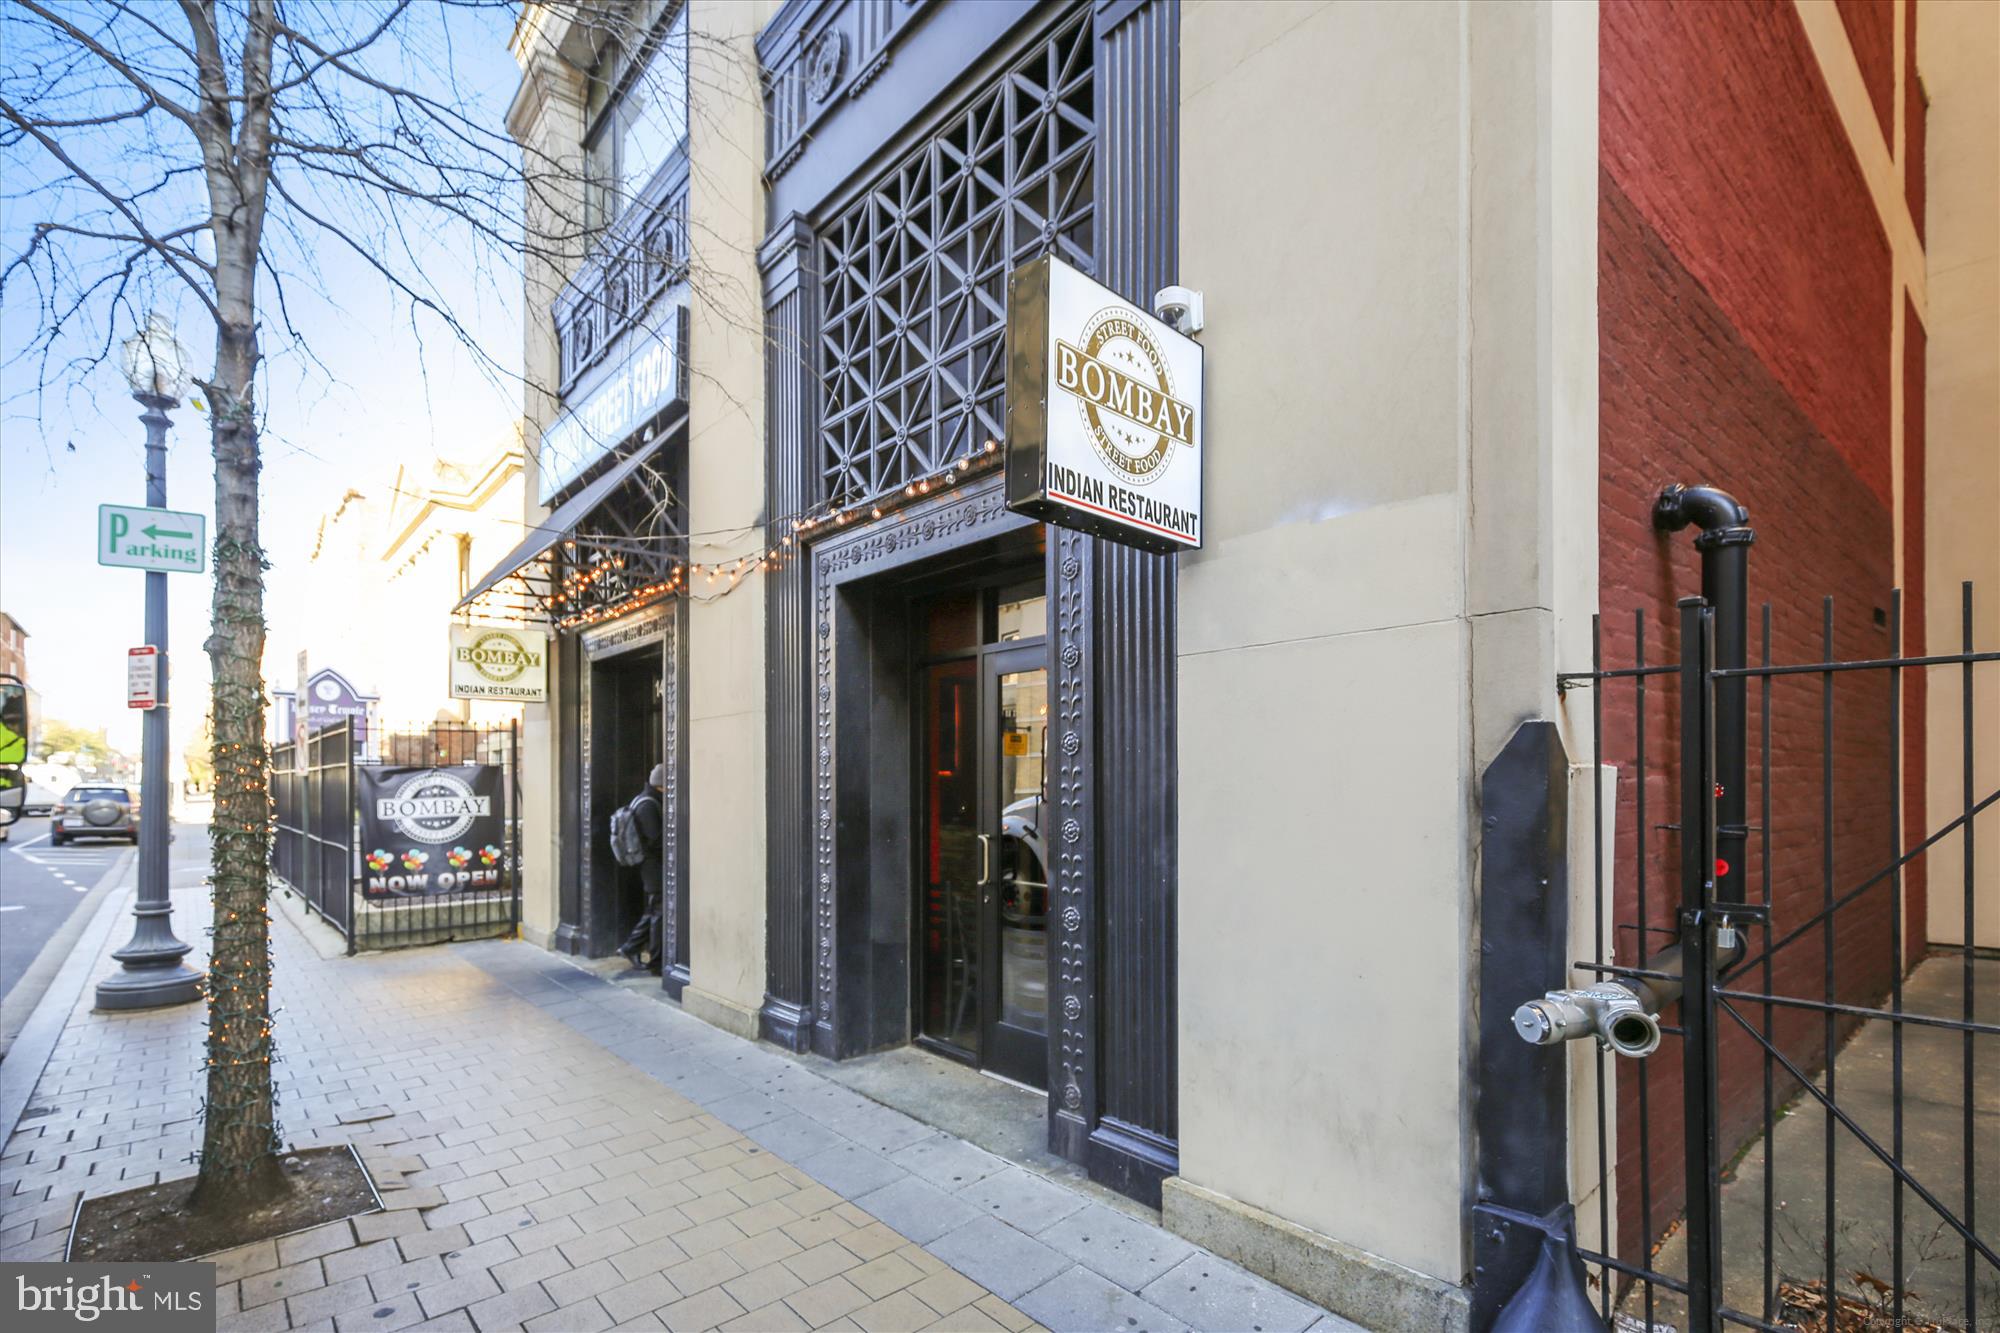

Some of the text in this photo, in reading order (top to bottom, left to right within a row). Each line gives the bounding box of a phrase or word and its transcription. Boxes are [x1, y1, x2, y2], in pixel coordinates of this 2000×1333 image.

[1096, 320, 1163, 377] STREET FOOD
[633, 336, 672, 414] FOOD
[1058, 346, 1194, 442] BOMBAY
[1094, 424, 1161, 473] STREET FOOD
[1049, 461, 1198, 537] INDIAN RESTAURANT
[109, 512, 198, 565] Parking
[459, 647, 539, 667] BOMBAY
[455, 684, 542, 697] INDIAN RESTAURANT
[383, 798, 487, 818] BOMBAY
[369, 869, 498, 894] NOW OPEN
